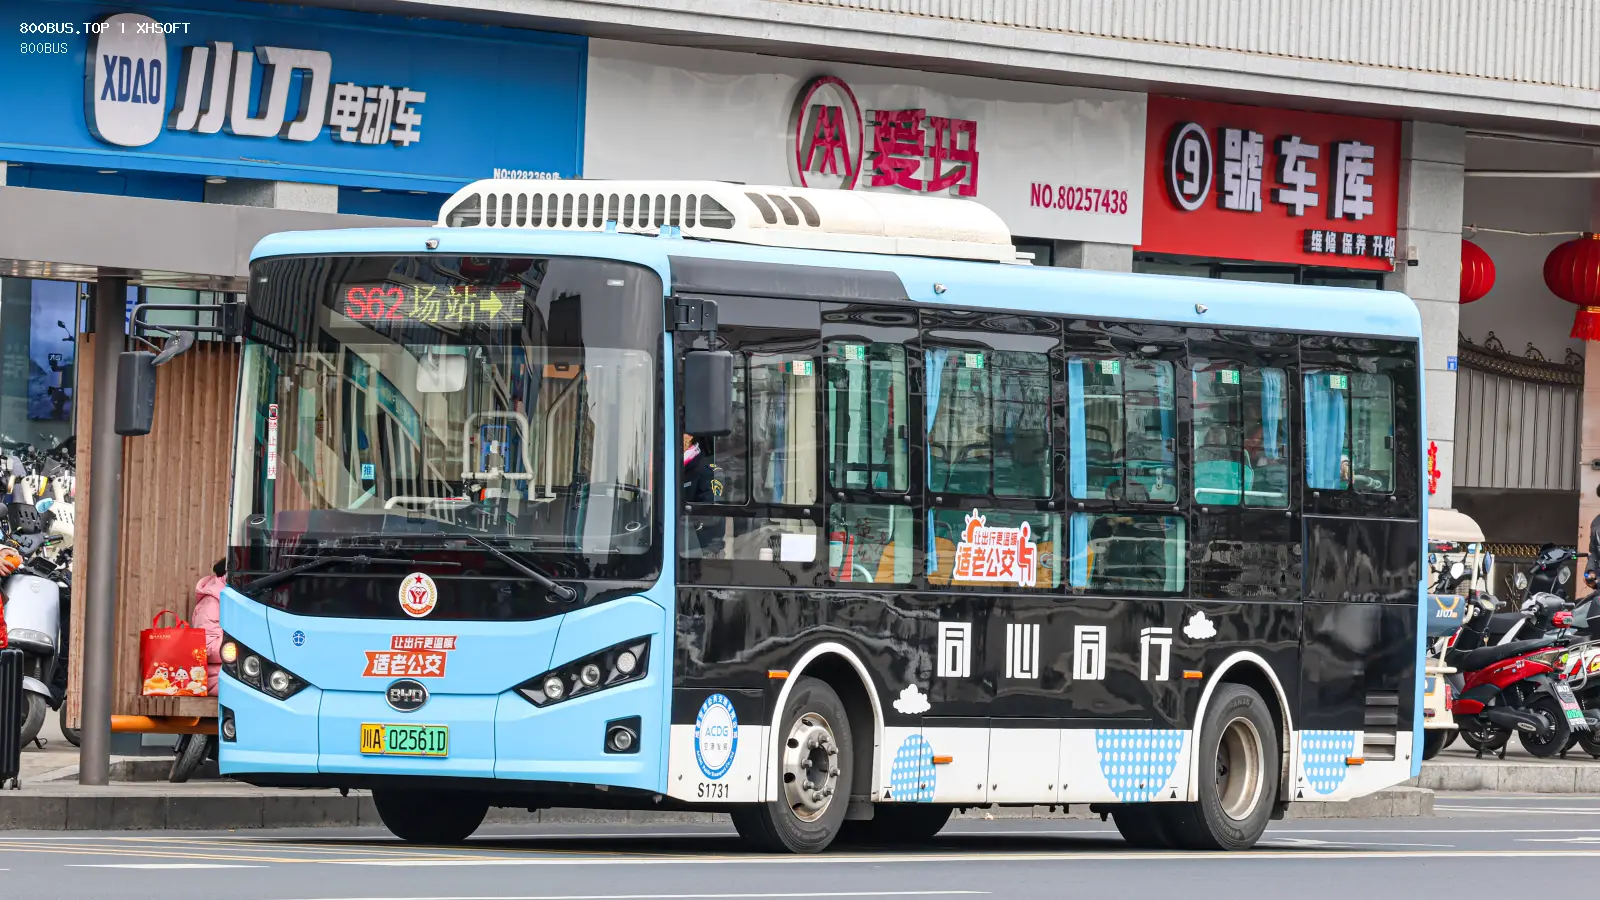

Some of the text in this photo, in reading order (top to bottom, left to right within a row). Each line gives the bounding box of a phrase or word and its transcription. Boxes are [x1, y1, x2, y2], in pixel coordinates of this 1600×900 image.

[100, 54, 162, 105] XDAO
[175, 41, 427, 147] 小刀 电动车
[873, 108, 980, 197] 爱玛
[1030, 182, 1129, 215] NO.80257438
[346, 287, 405, 319] S62
[409, 285, 477, 322] 场站
[974, 530, 1018, 546] 让出行更温暖
[955, 547, 1016, 578] 适老公交
[394, 637, 454, 649] 让出行更温暖
[937, 621, 1173, 681] 同心同行
[371, 653, 443, 675] 适老公交
[390, 688, 423, 702] BYD
[363, 729, 446, 751] 川A 02561D
[705, 725, 729, 737] ACDG
[697, 782, 729, 799] S1731
